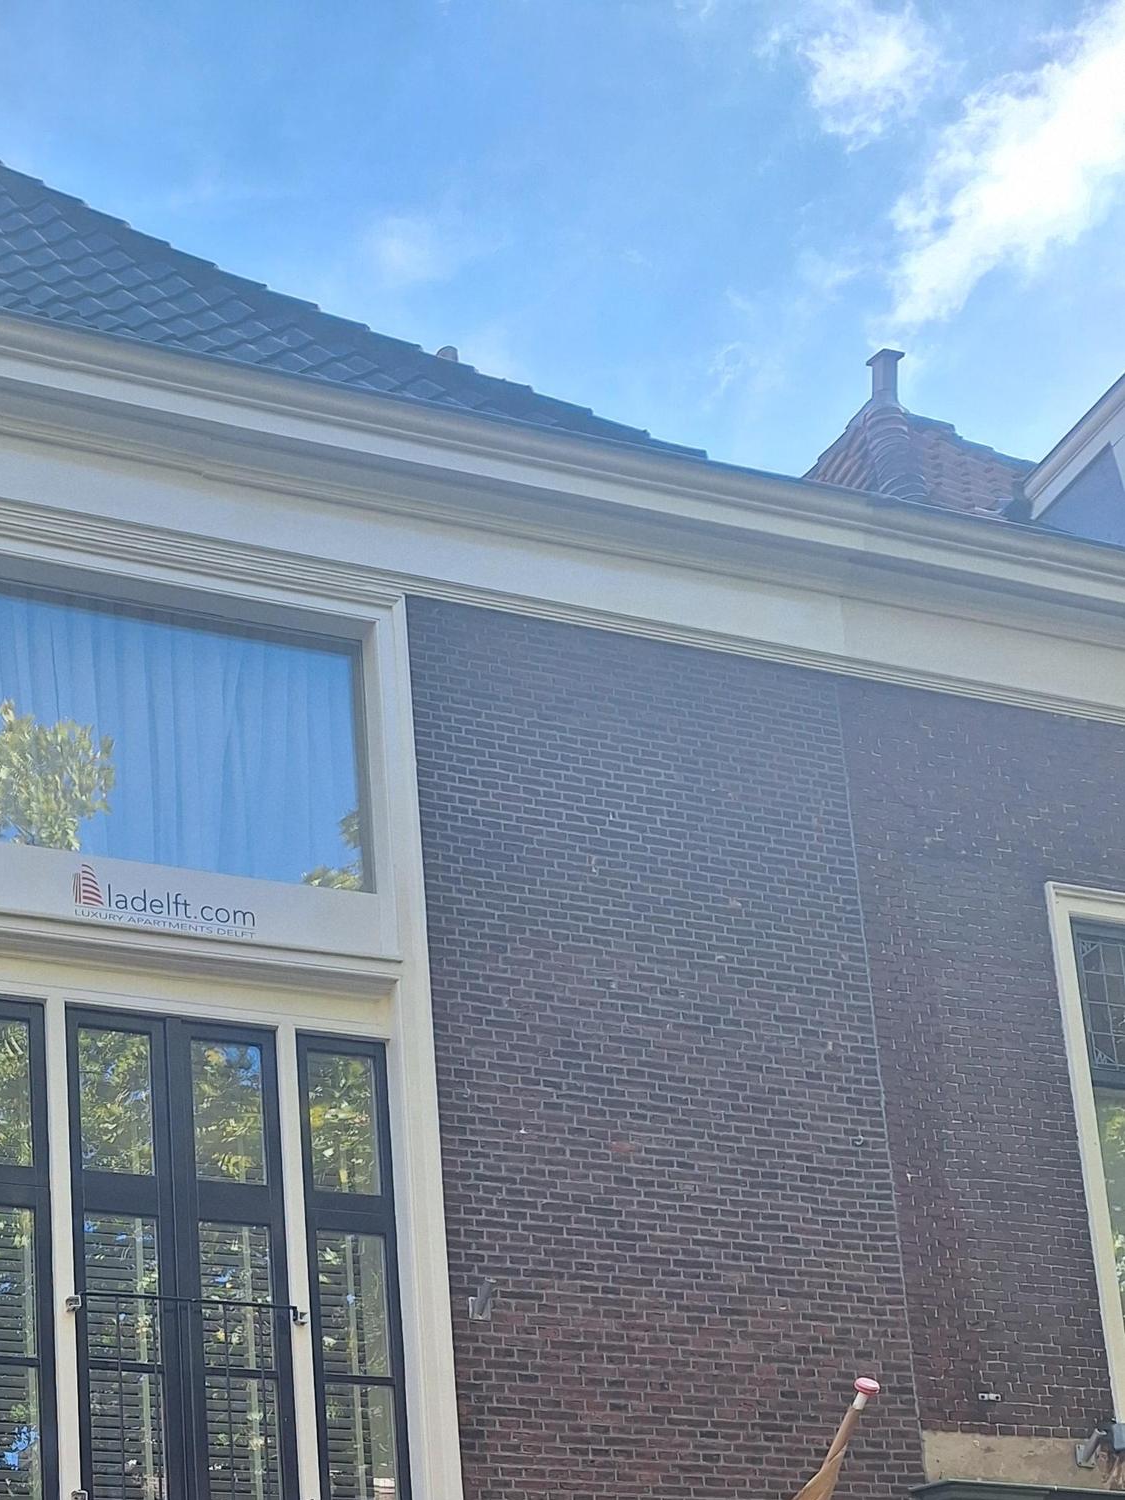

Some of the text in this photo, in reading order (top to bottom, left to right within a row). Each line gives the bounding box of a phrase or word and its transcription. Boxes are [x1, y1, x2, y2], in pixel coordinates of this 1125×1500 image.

[107, 883, 256, 927] ladelft.com
[74, 909, 257, 940] LUXURY APARTMENTS DELFT
